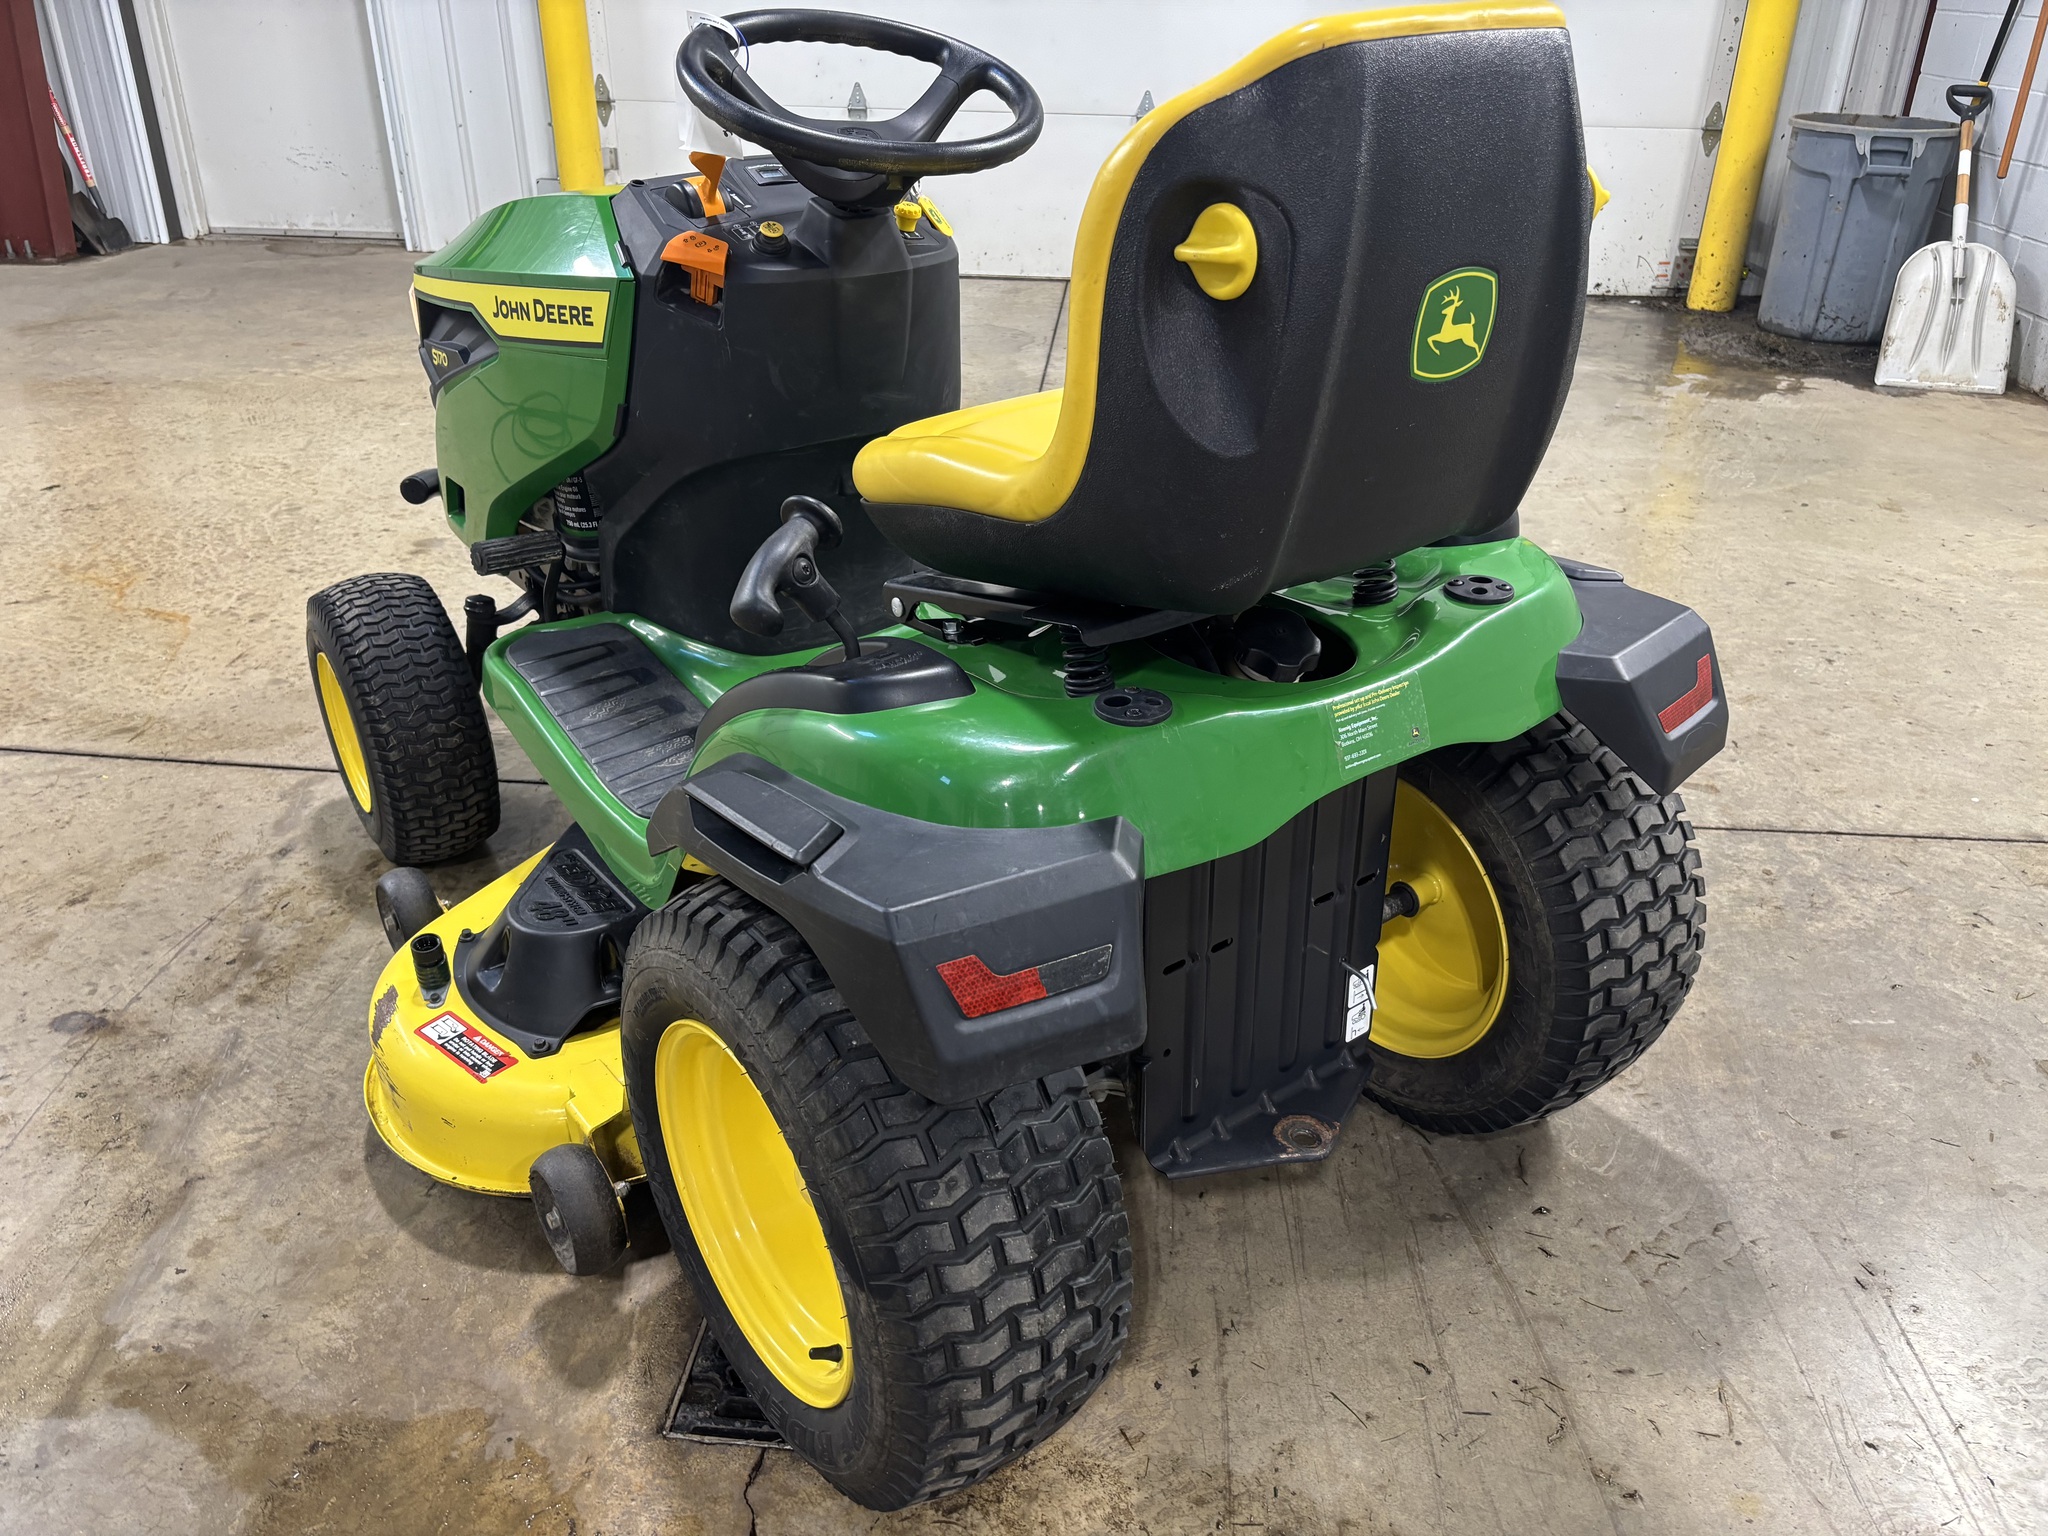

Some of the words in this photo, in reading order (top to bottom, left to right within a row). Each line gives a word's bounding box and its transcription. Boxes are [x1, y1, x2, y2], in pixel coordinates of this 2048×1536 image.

[493, 296, 531, 322] JOHN
[533, 298, 594, 326] DEERE
[460, 1036, 484, 1054] ROTATING
[481, 1050, 498, 1064] BLADE
